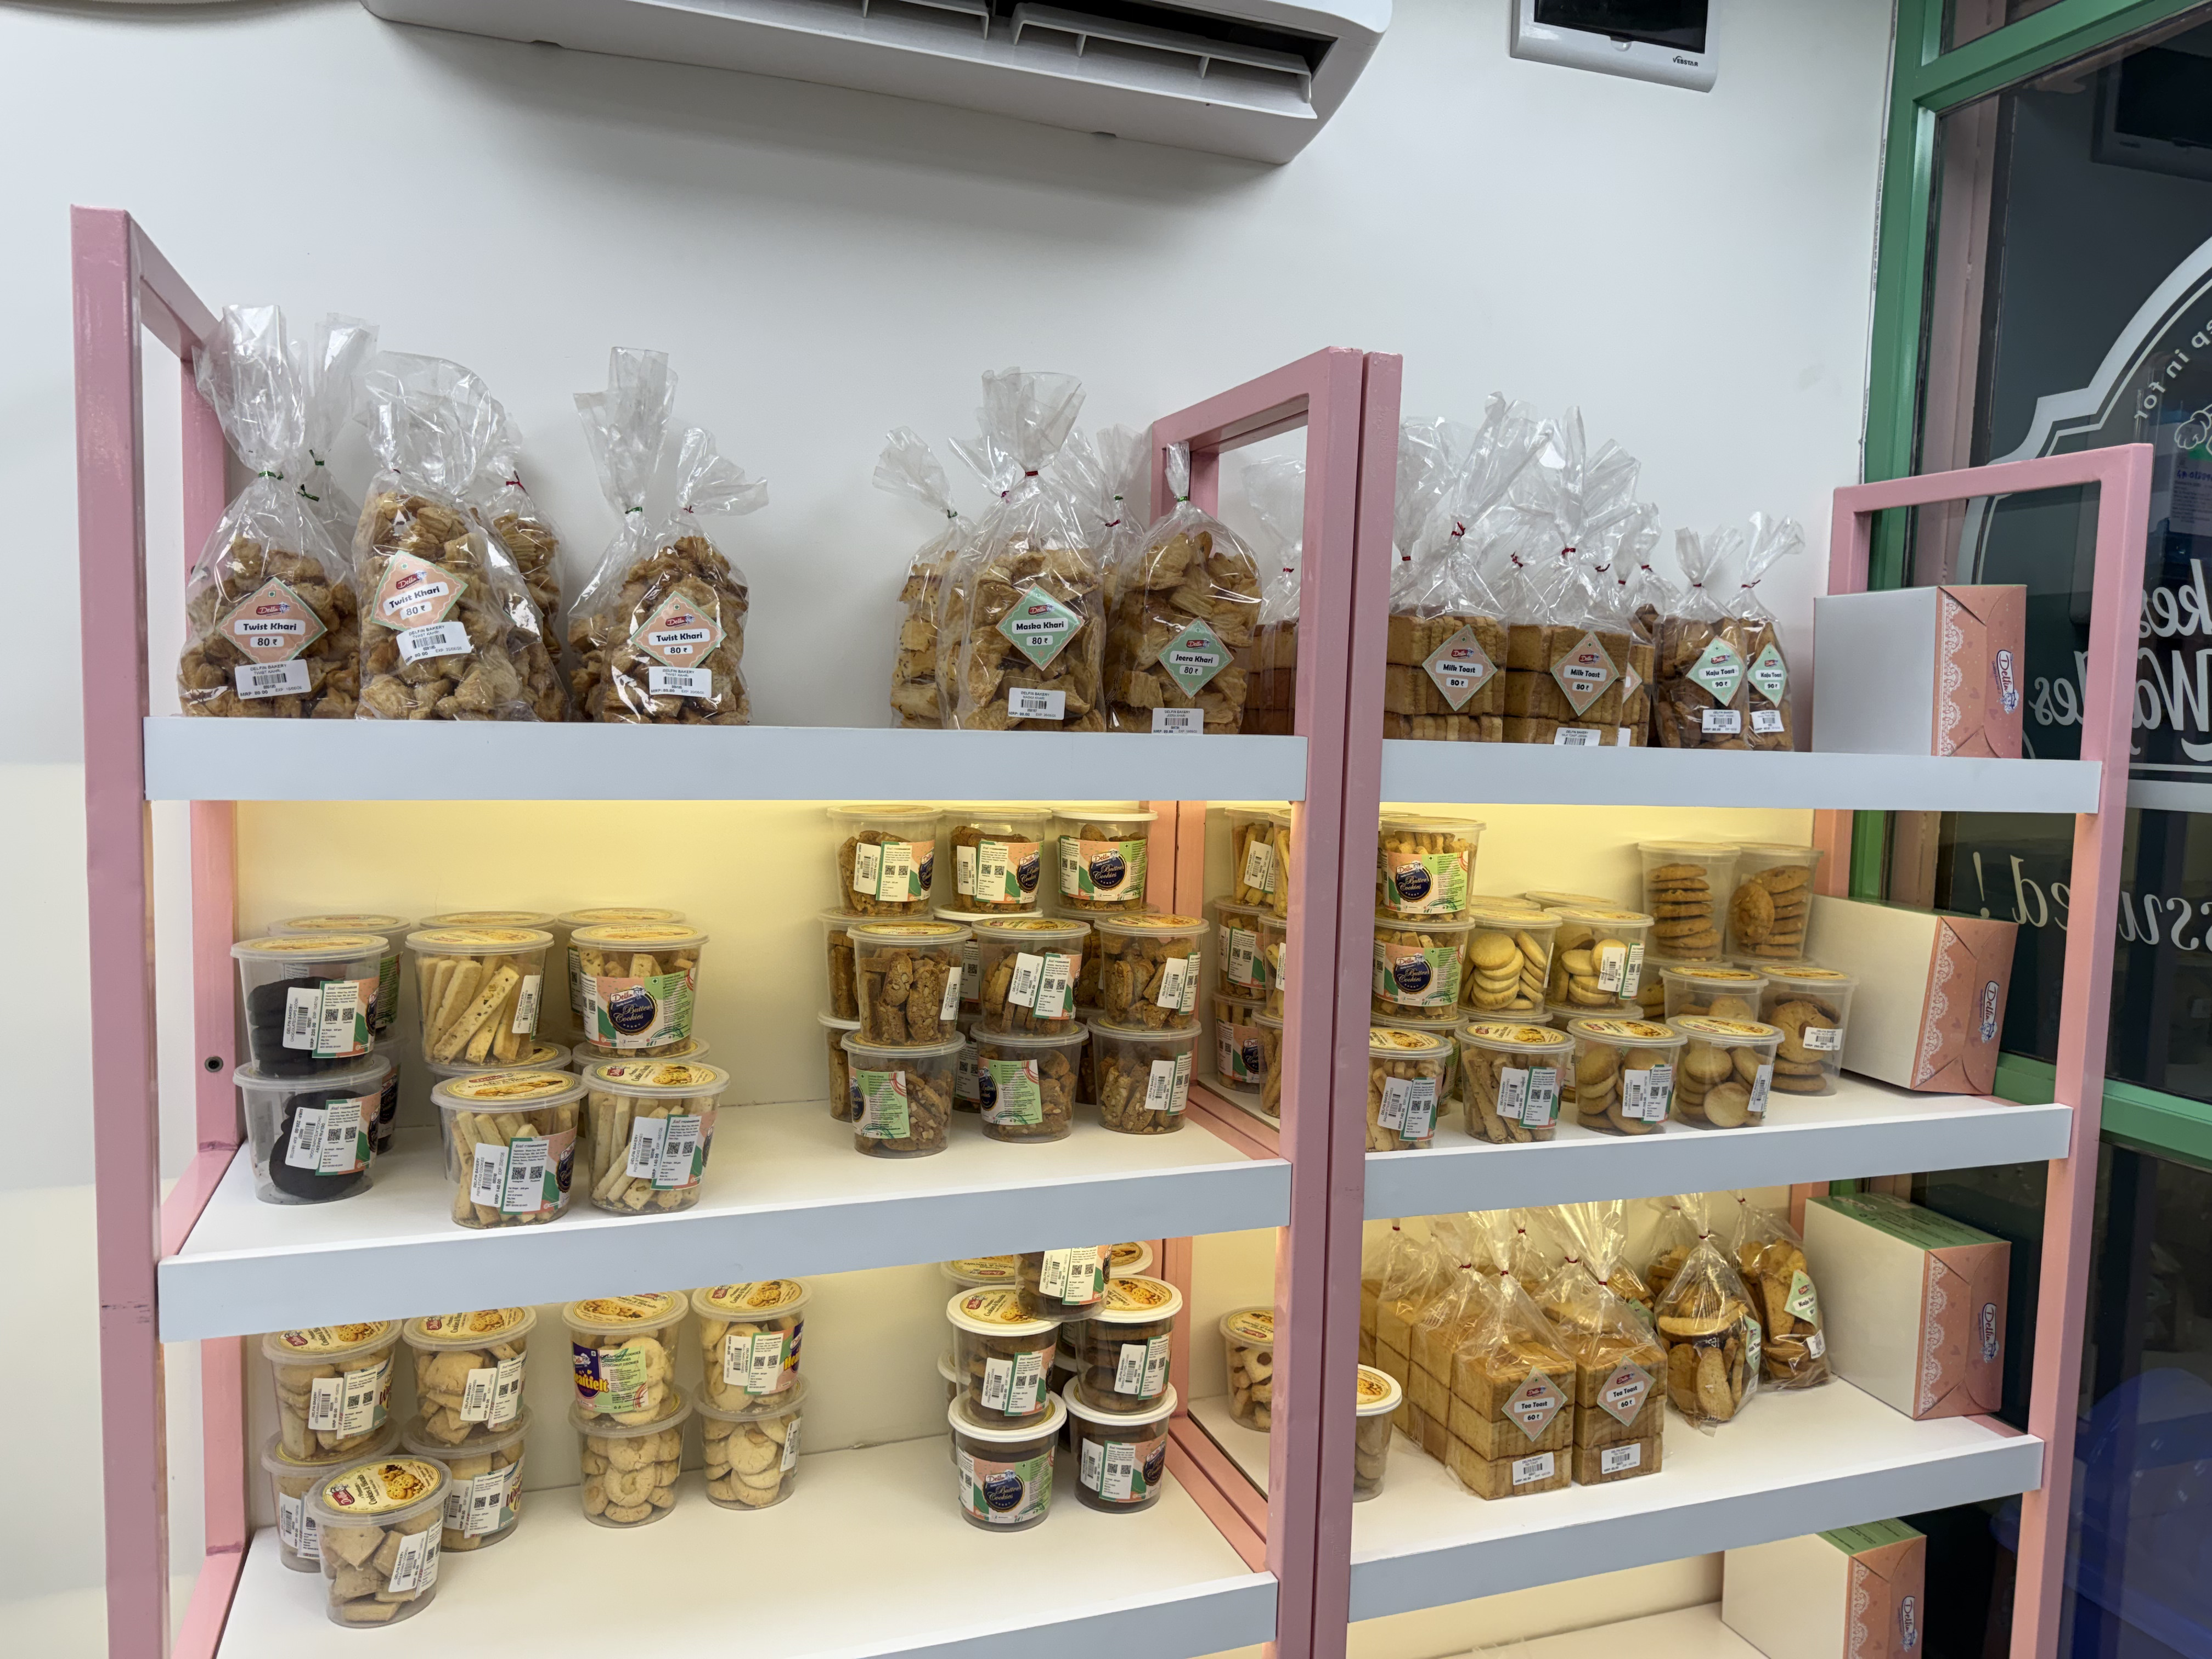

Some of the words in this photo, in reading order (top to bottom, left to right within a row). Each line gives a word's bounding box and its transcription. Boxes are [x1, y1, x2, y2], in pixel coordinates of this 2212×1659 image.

[389, 595, 413, 608] Twist
[414, 586, 440, 599] Khari
[407, 607, 419, 616] 80
[1043, 621, 1064, 629] Khari
[657, 633, 678, 642] Twist
[680, 632, 702, 640] Khari
[1195, 656, 1213, 664] Khari
[1999, 653, 2012, 691] Delfin
[1101, 864, 1122, 872] Butter
[1093, 871, 1116, 879] Cookies
[613, 991, 633, 1001] Delfin
[1985, 984, 1996, 1022] Delfin
[623, 1003, 651, 1014] Butter
[613, 1013, 644, 1023] Cookies
[1985, 1306, 1994, 1343] Delfin
[1624, 1386, 1637, 1394] Toast
[1904, 1600, 1912, 1633] Delfin
